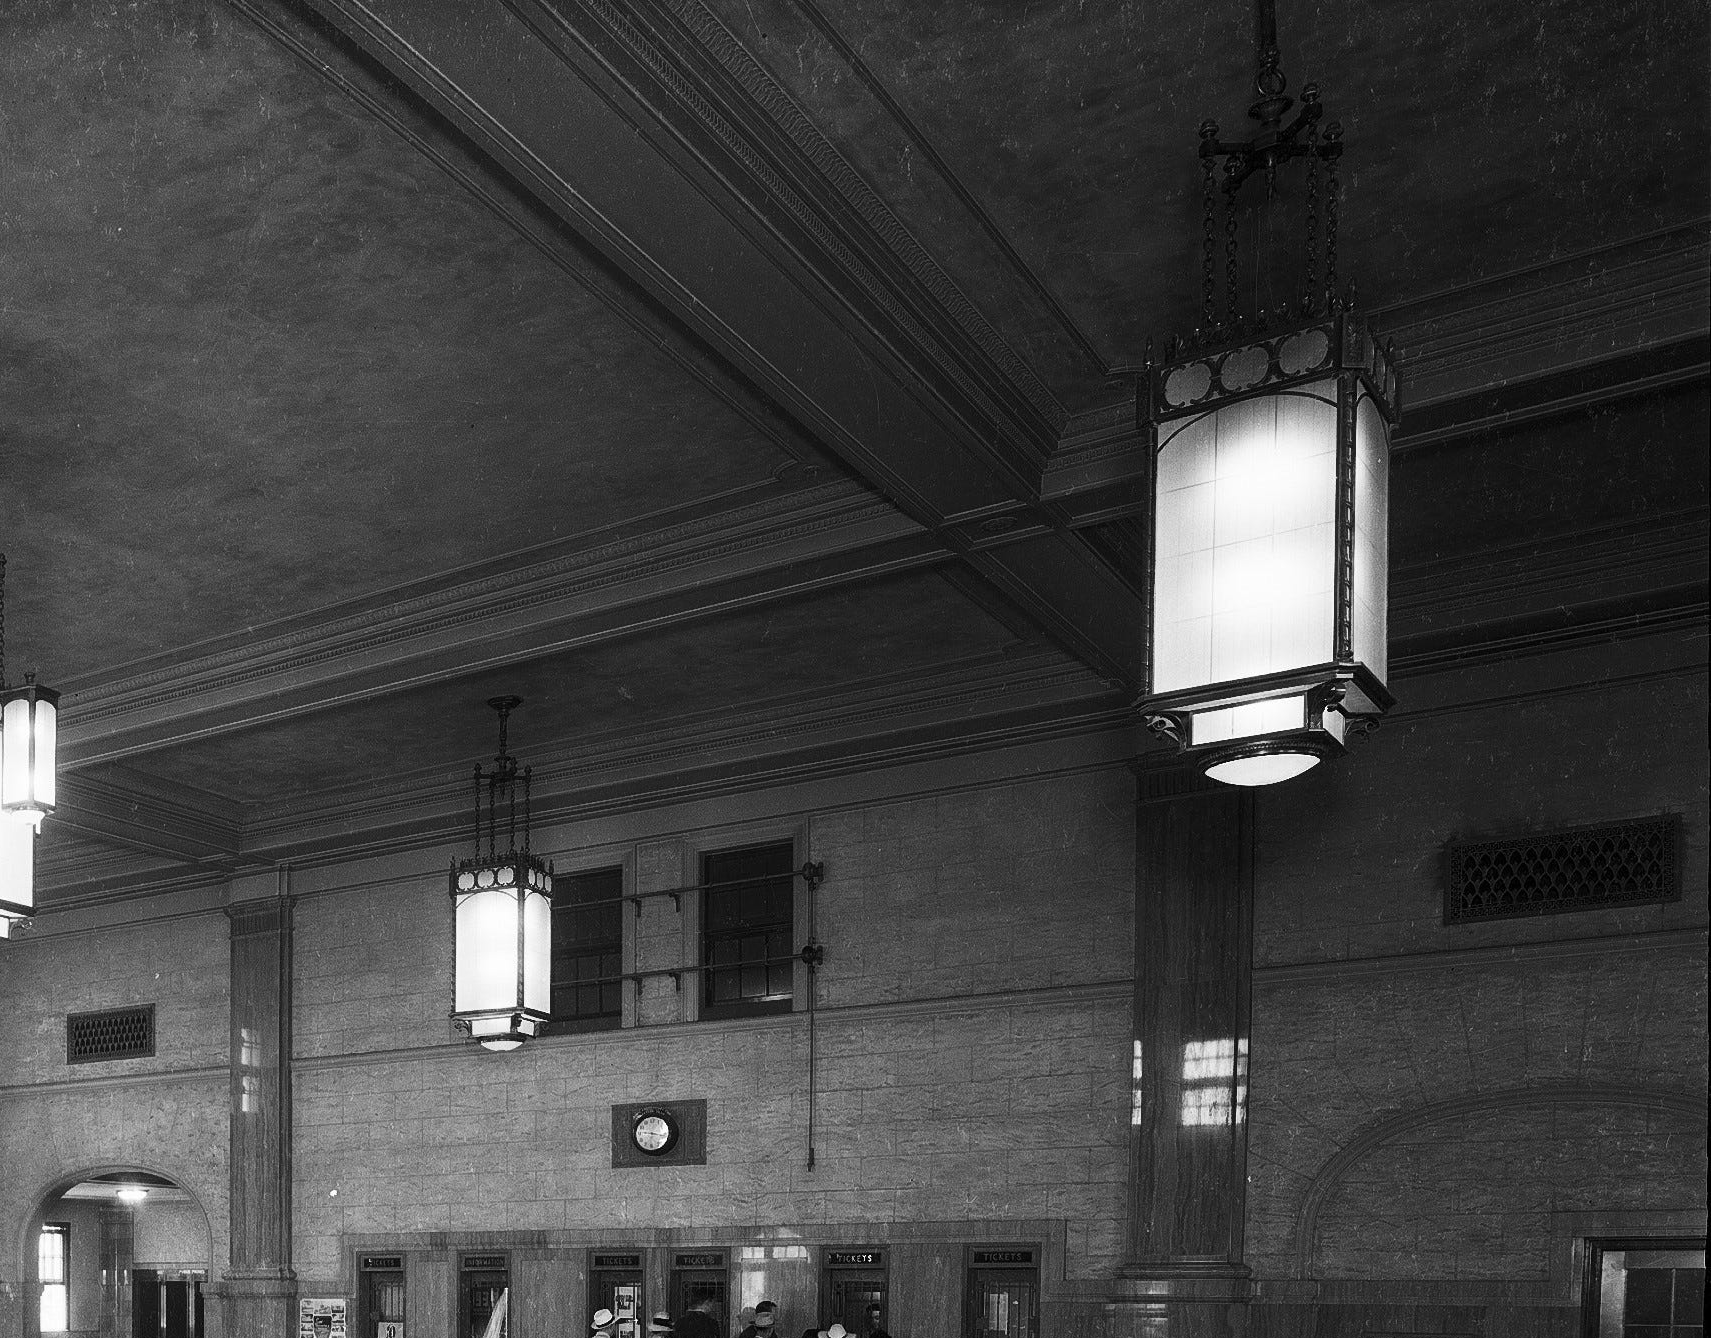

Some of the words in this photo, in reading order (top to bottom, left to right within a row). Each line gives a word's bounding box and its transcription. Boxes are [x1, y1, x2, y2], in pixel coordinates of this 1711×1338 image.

[602, 1257, 633, 1265] TICKETS
[683, 1256, 715, 1265] TICKETS
[837, 1254, 872, 1263] TICKETS
[983, 1253, 1022, 1261] TICKETS
